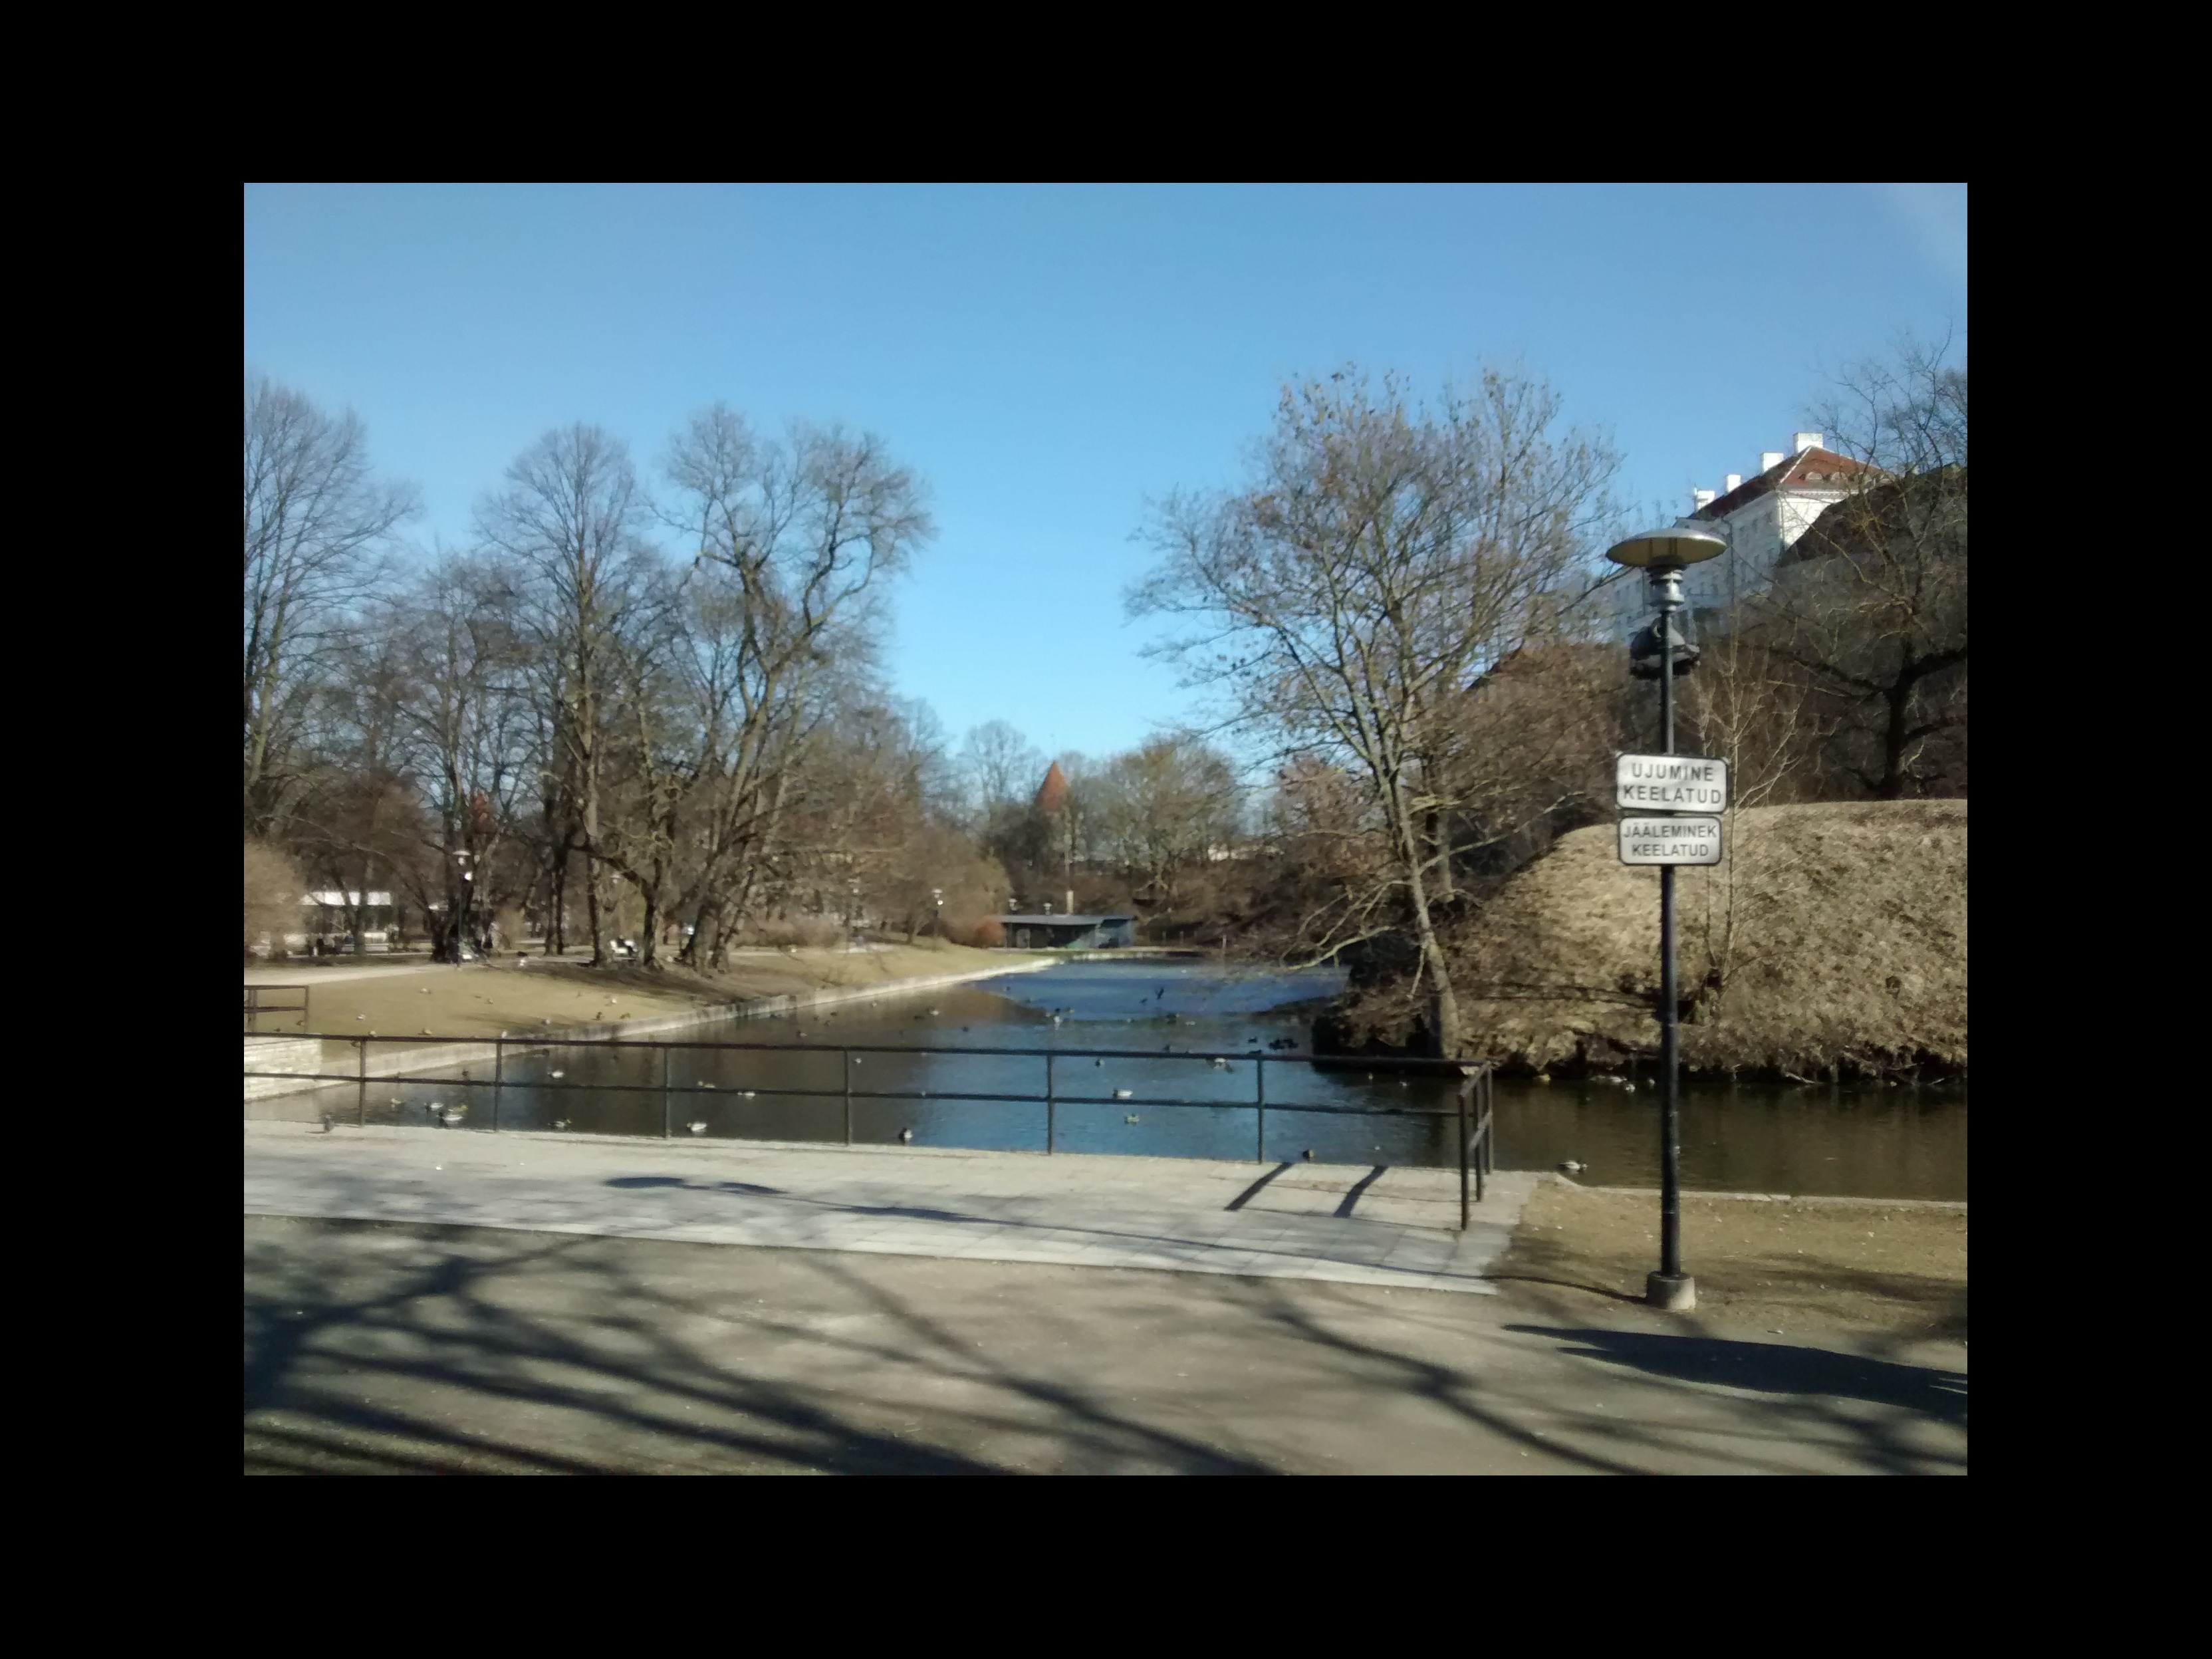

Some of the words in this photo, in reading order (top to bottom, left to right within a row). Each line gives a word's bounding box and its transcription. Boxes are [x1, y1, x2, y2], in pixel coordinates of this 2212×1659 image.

[1632, 763, 1714, 782] UJUMINE
[1623, 785, 1721, 804] KEELATUD
[1624, 822, 1717, 838] JÄÄLEMINEK
[1632, 844, 1709, 856] KEELATUD
